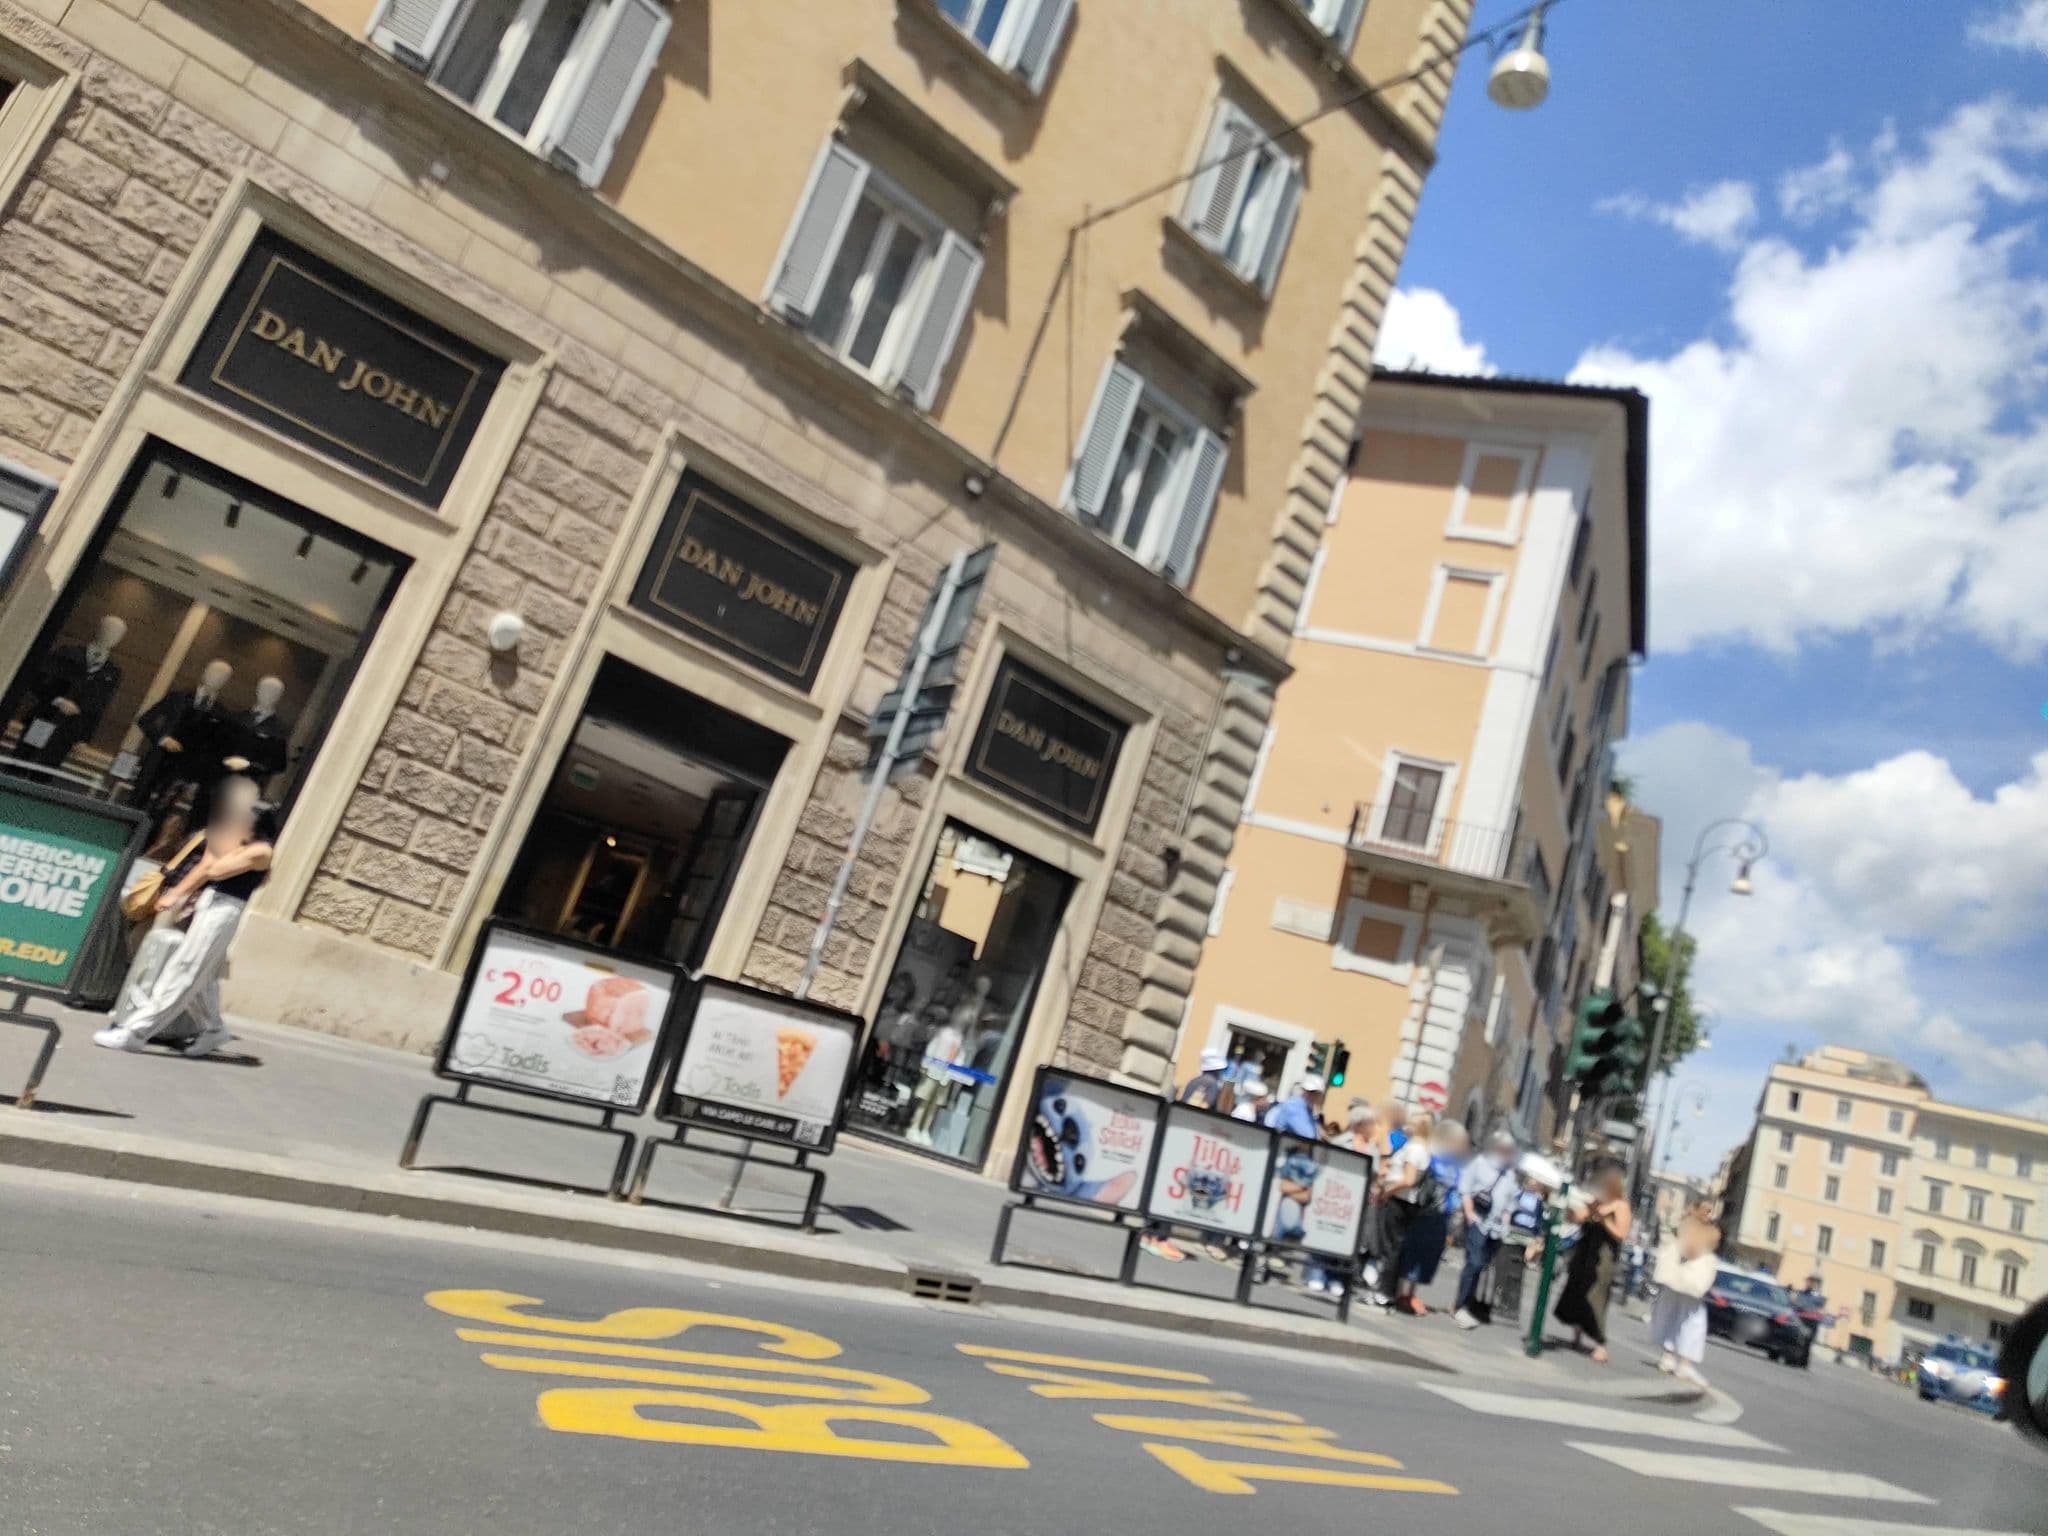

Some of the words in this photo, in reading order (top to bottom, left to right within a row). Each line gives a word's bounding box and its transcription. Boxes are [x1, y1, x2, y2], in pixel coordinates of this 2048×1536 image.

[251, 308, 346, 374] DAN
[337, 360, 451, 430] JOHN
[678, 536, 744, 586] DAN
[737, 571, 819, 626] JOHN
[997, 711, 1046, 751] DAN
[1039, 738, 1100, 778] JOHN
[424, 1289, 1031, 1469] BUS
[954, 1343, 1462, 1495] TAXI
